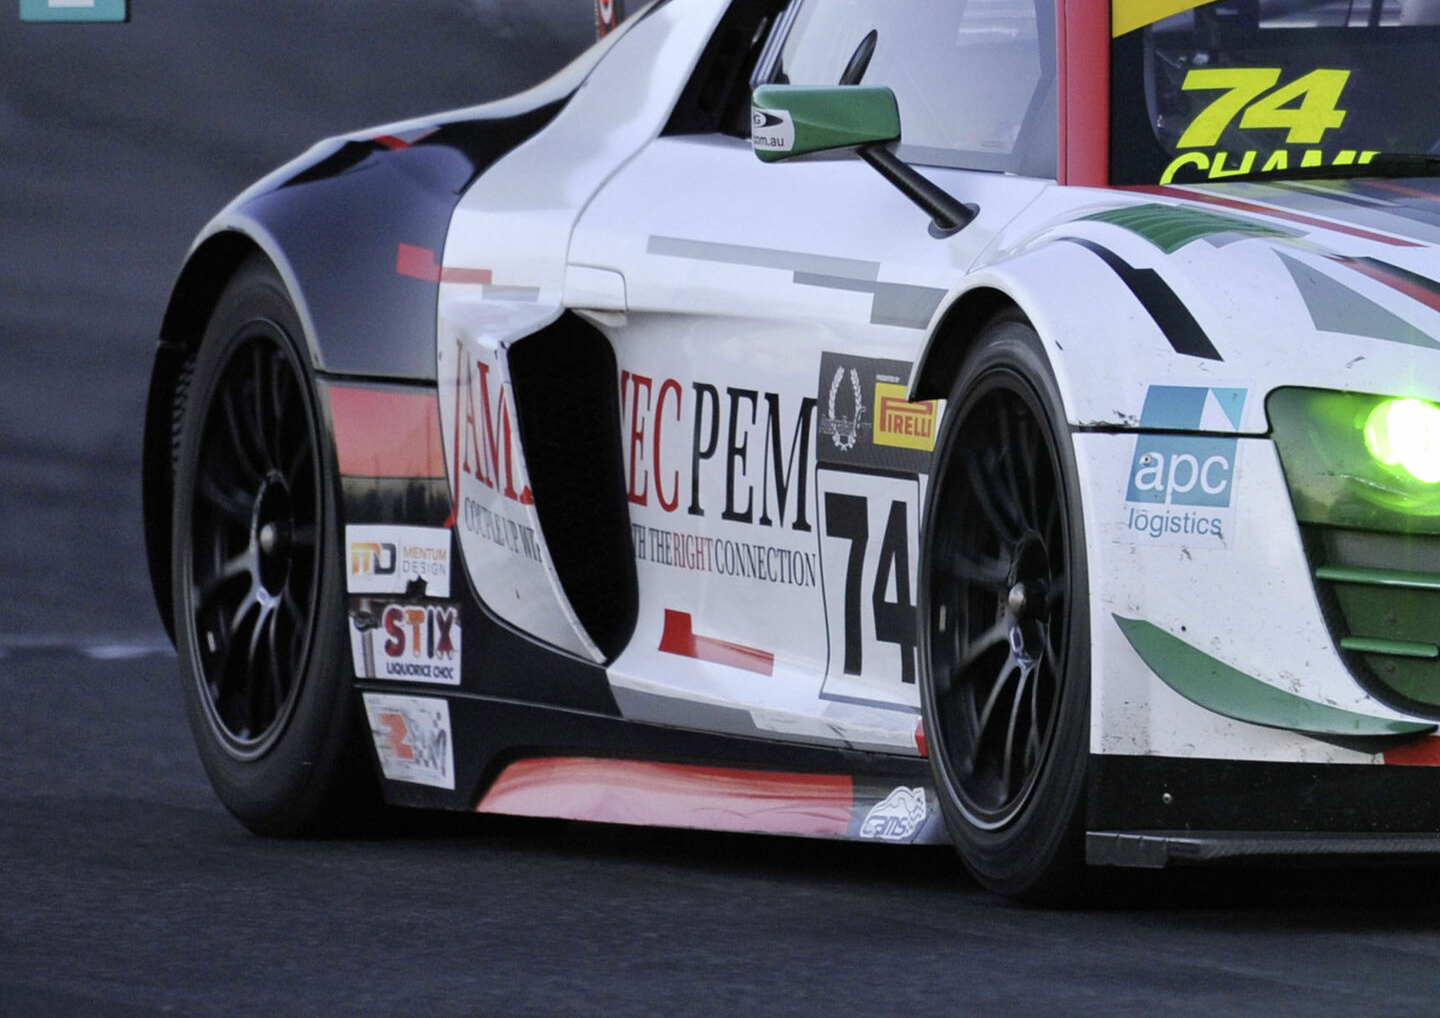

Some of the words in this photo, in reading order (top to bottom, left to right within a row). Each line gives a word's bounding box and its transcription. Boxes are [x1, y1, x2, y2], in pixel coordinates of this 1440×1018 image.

[1177, 67, 1351, 148] 74
[880, 396, 933, 439] PIRELLI
[1134, 451, 1229, 504] apc
[1128, 507, 1223, 538] logistics
[402, 560, 446, 575] DESIGN
[648, 529, 673, 566] THE
[673, 532, 714, 572] RIGHT
[714, 538, 817, 588] CONNECTION
[824, 491, 918, 685] 74
[384, 606, 457, 660] STIX
